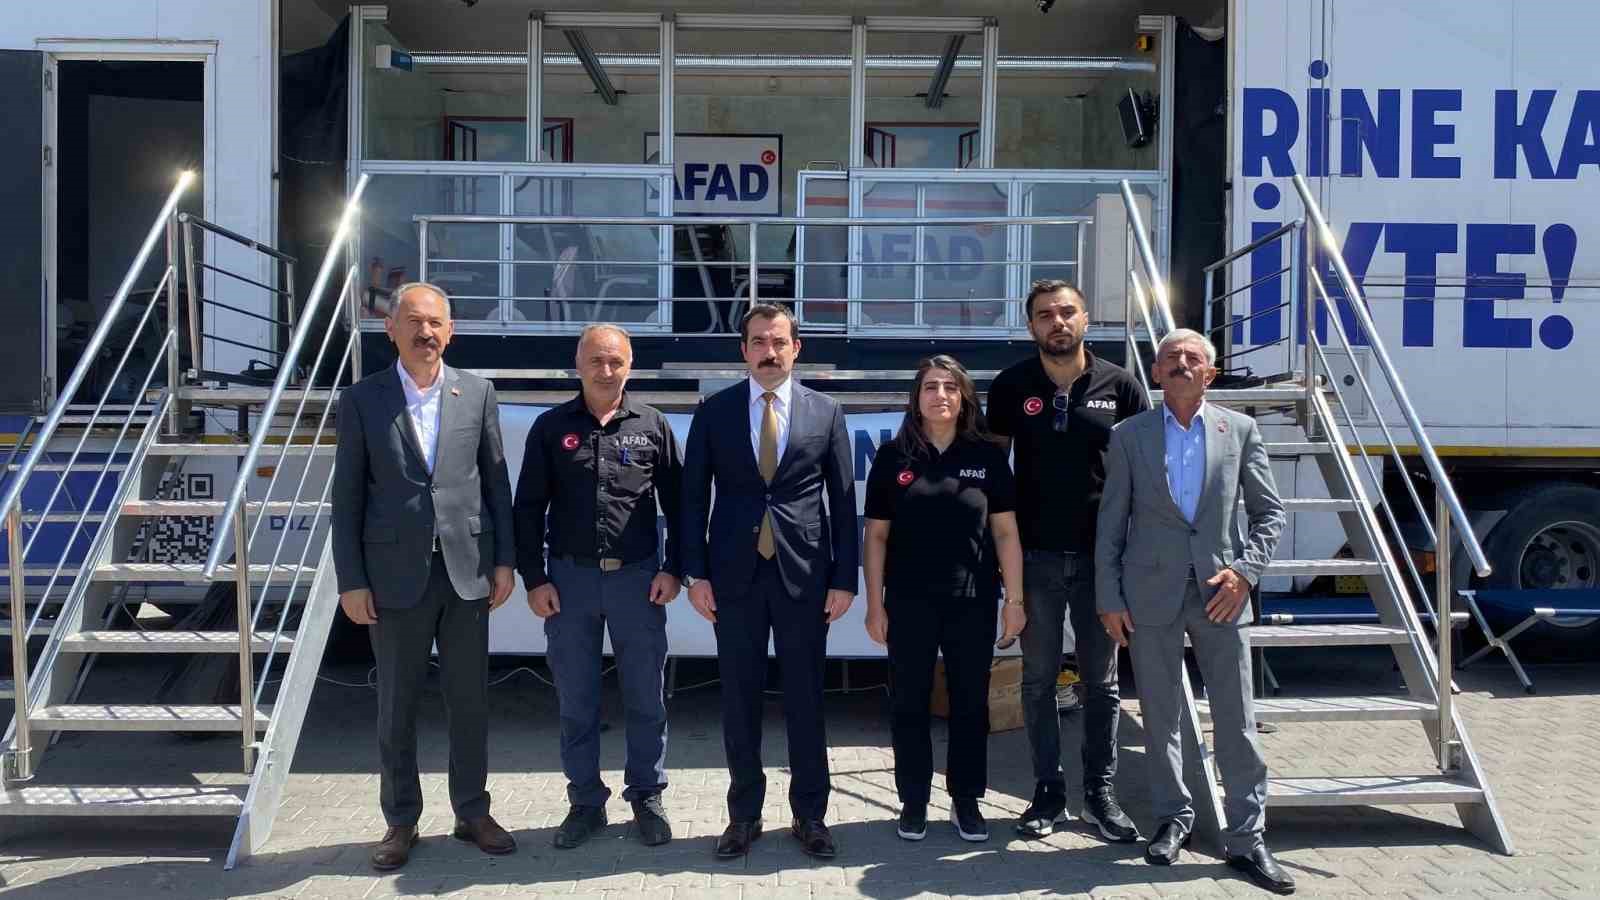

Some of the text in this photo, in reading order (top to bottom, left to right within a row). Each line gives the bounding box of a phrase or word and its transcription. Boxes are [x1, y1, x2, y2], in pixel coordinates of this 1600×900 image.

[1242, 60, 1463, 179] RİNE
[1232, 182, 1578, 350] İKTE!
[1087, 400, 1117, 410] AFAD
[622, 435, 648, 446] AFAD
[959, 469, 986, 479] AFAD
